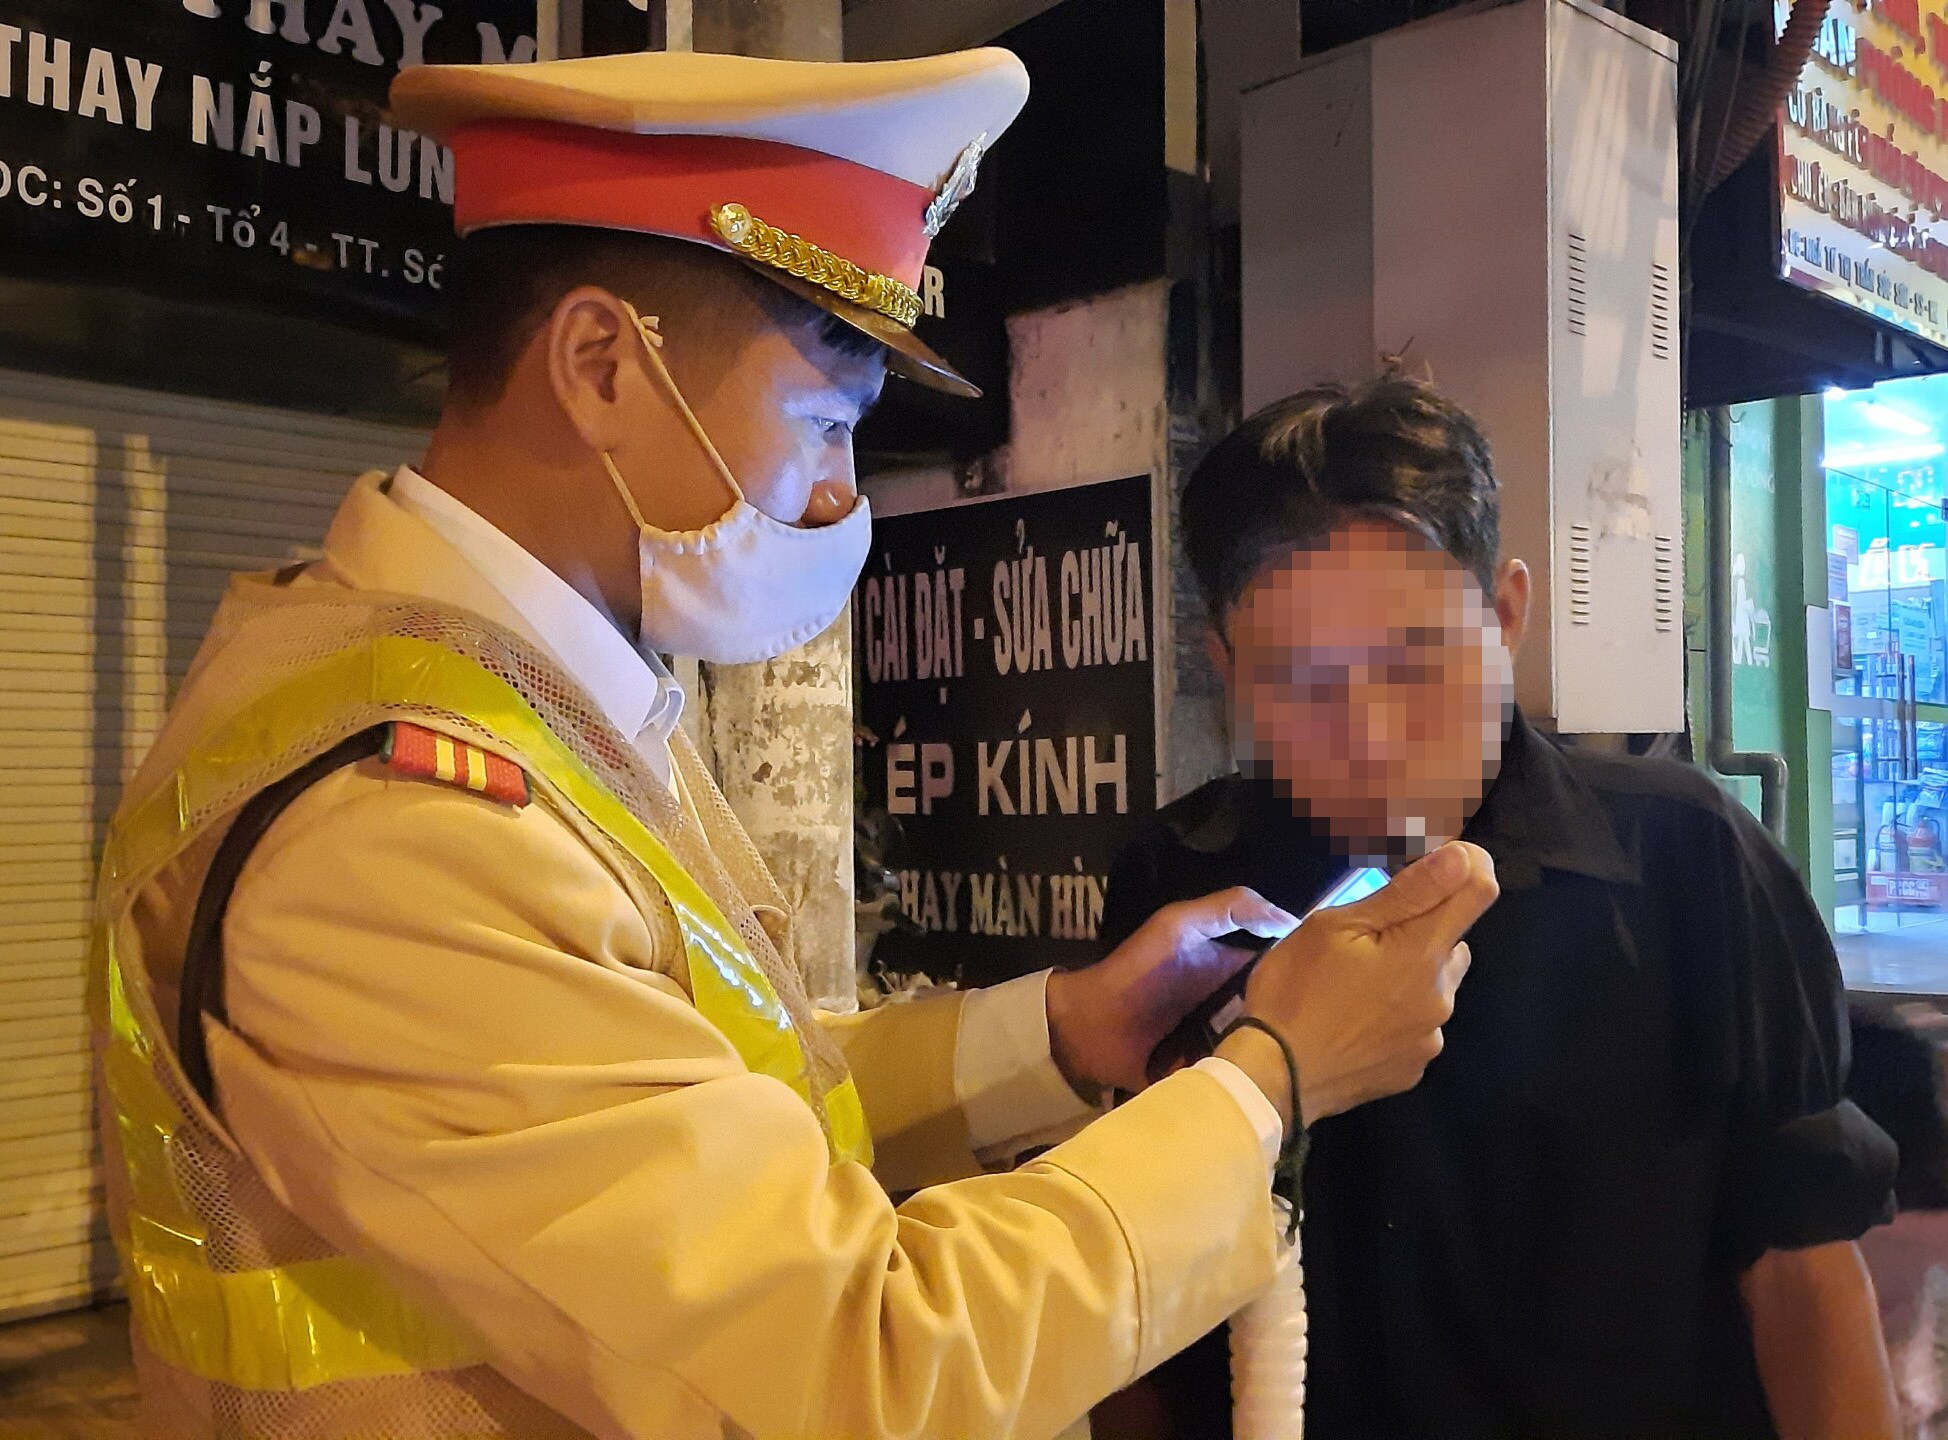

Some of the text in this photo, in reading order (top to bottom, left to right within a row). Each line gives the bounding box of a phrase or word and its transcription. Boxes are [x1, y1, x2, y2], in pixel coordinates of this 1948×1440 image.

[183, 0, 443, 68] HAY
[0, 23, 163, 131] THAY
[192, 60, 321, 167] NẮP
[77, 178, 137, 223] Số
[147, 194, 162, 230] 1
[206, 204, 261, 248] Tổ
[269, 221, 290, 255] 4
[331, 233, 390, 278] TT.
[924, 265, 945, 318] R
[914, 545, 965, 704] ĐẶT
[993, 518, 1053, 675] SỬA
[1061, 520, 1147, 669] CHỮA
[887, 708, 1127, 816] ÉP KÍNH
[970, 855, 1041, 937] MÀN
